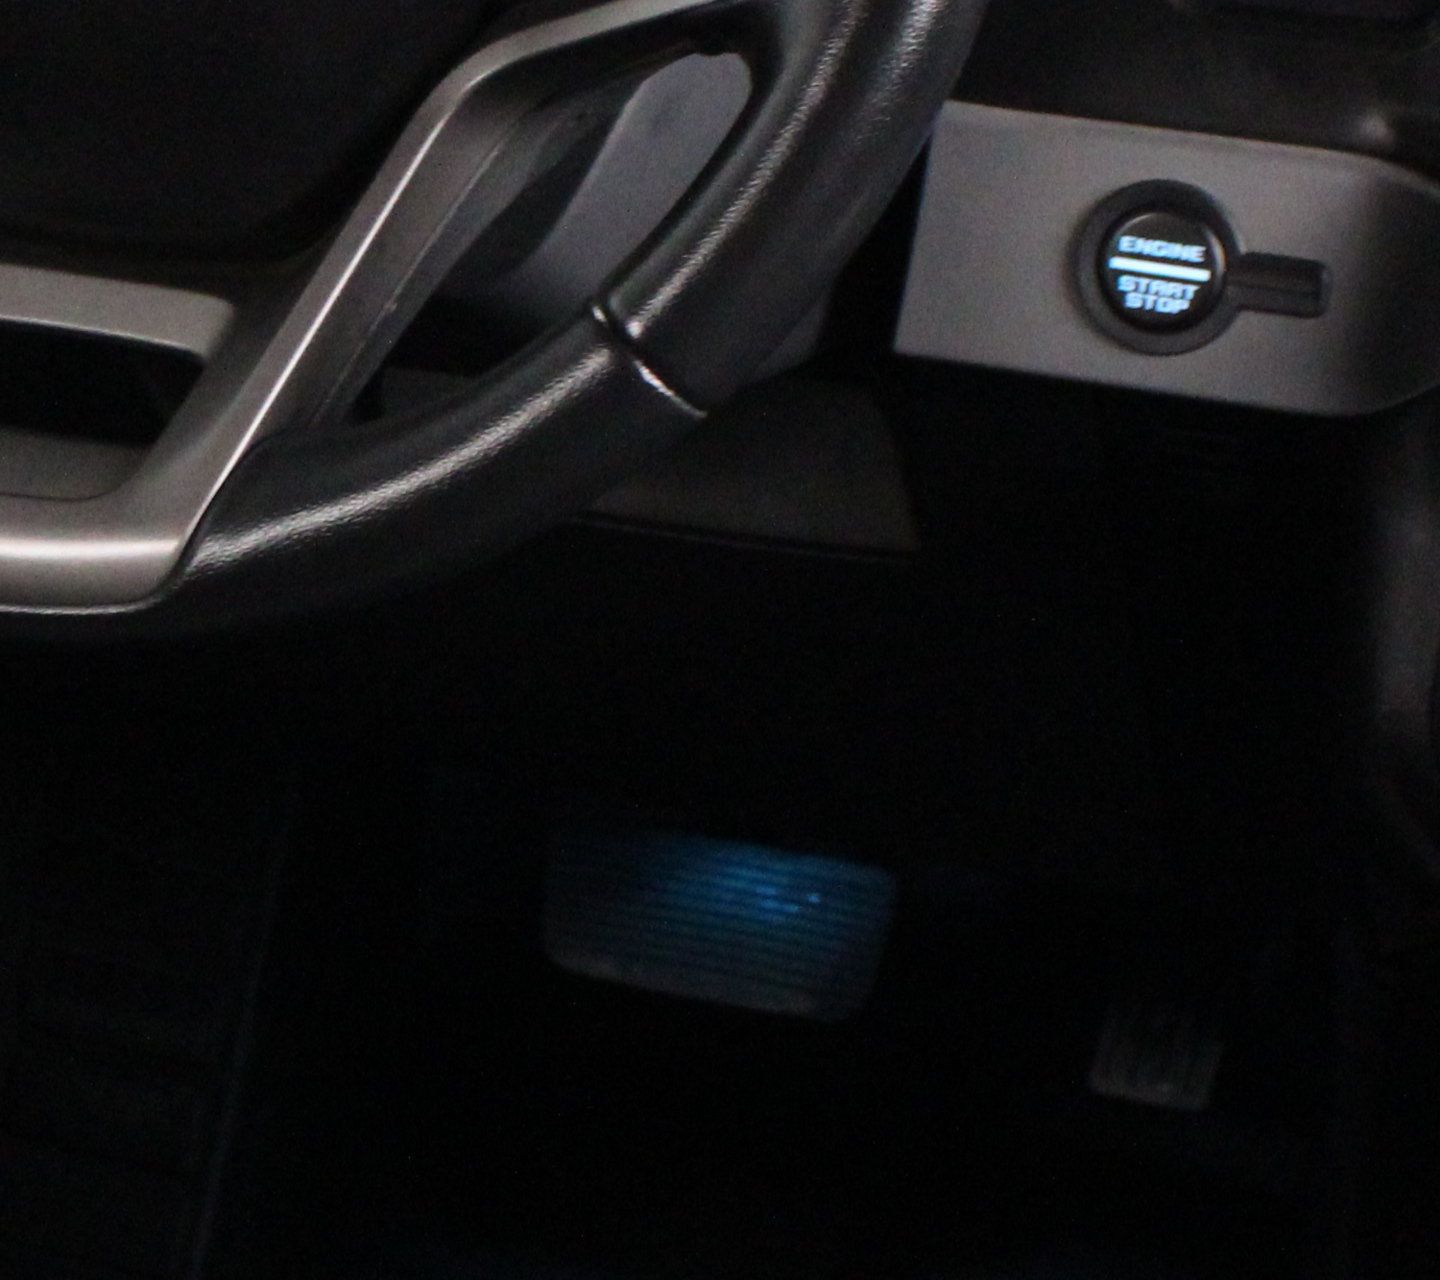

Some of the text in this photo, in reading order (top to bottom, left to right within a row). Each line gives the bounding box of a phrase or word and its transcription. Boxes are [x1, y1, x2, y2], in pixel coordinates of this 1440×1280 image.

[1117, 235, 1206, 264] ENGINE
[1117, 274, 1200, 300] START
[1124, 292, 1191, 315] STOP
